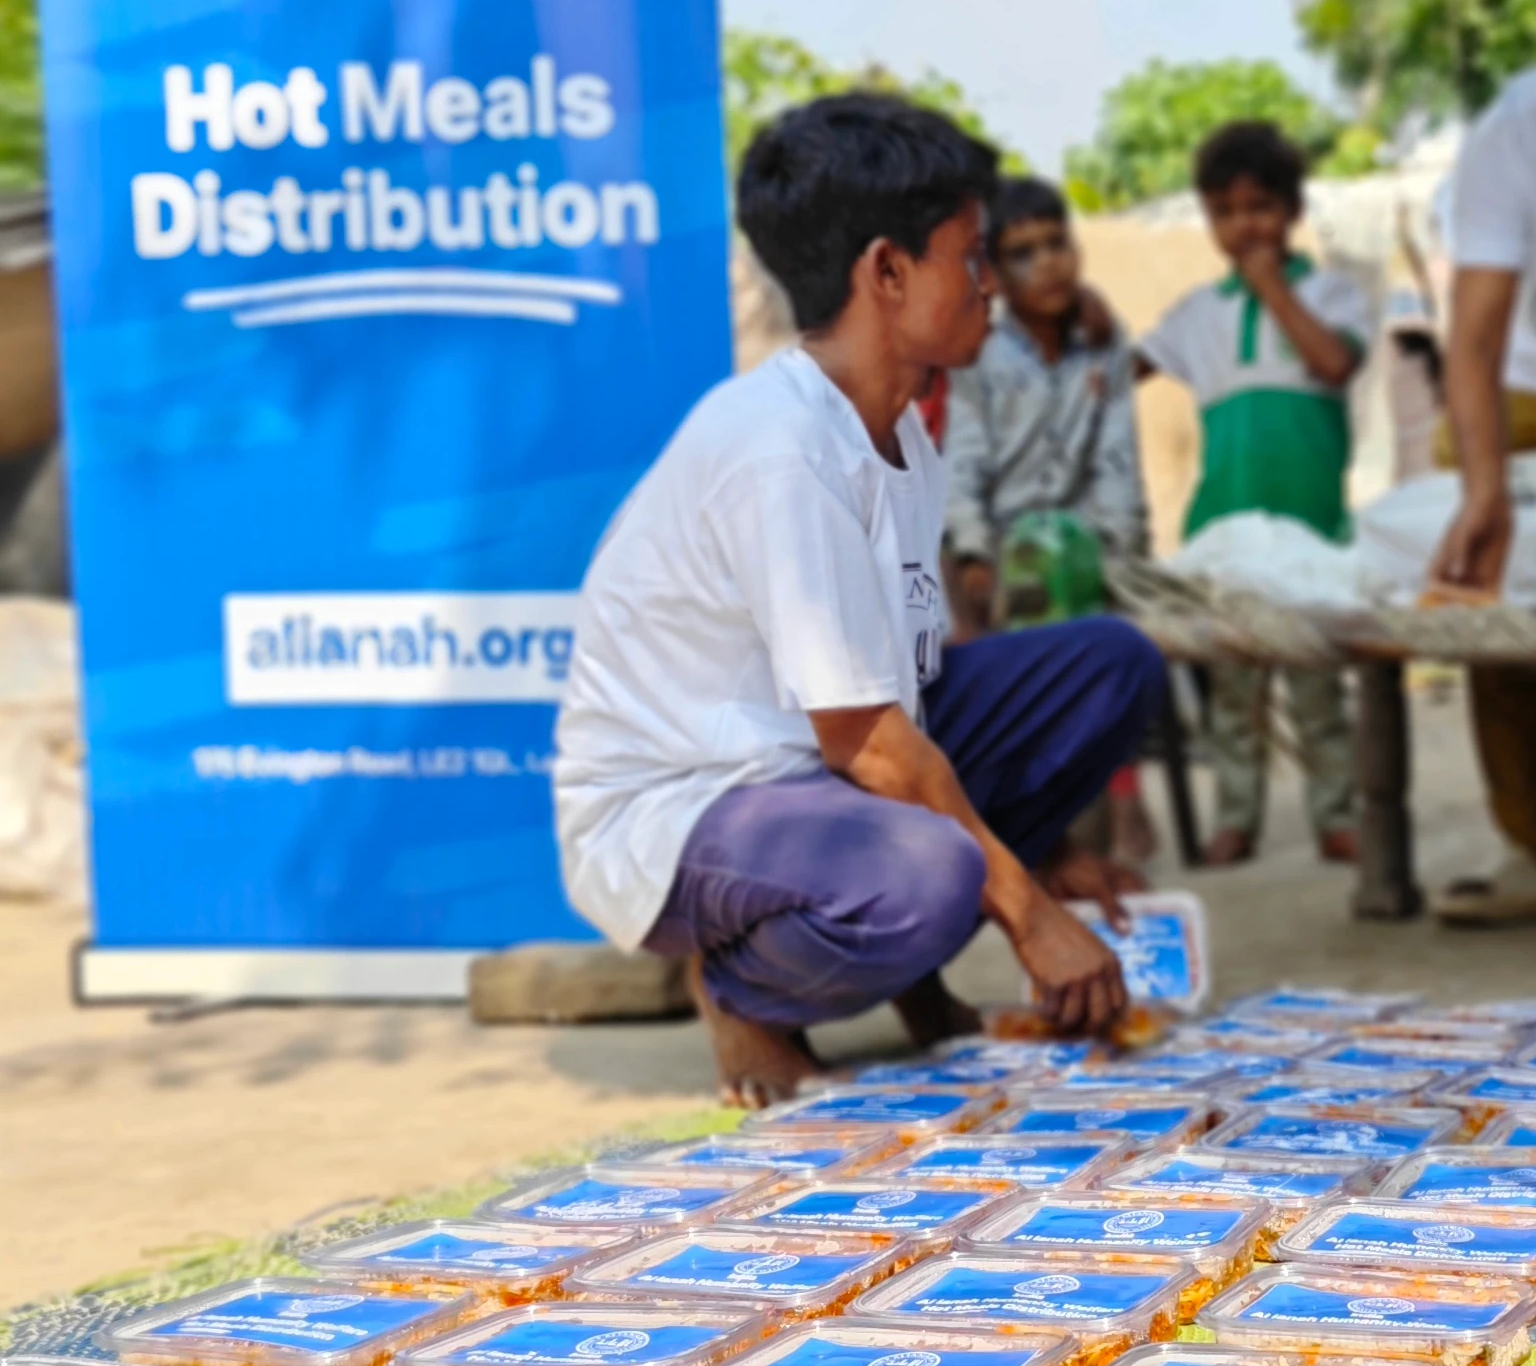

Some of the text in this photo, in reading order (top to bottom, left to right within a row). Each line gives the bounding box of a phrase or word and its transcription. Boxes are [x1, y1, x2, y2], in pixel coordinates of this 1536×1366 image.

[164, 55, 616, 152] Hot Meals
[132, 165, 657, 258] Distribution
[247, 613, 574, 681] alianah.org
